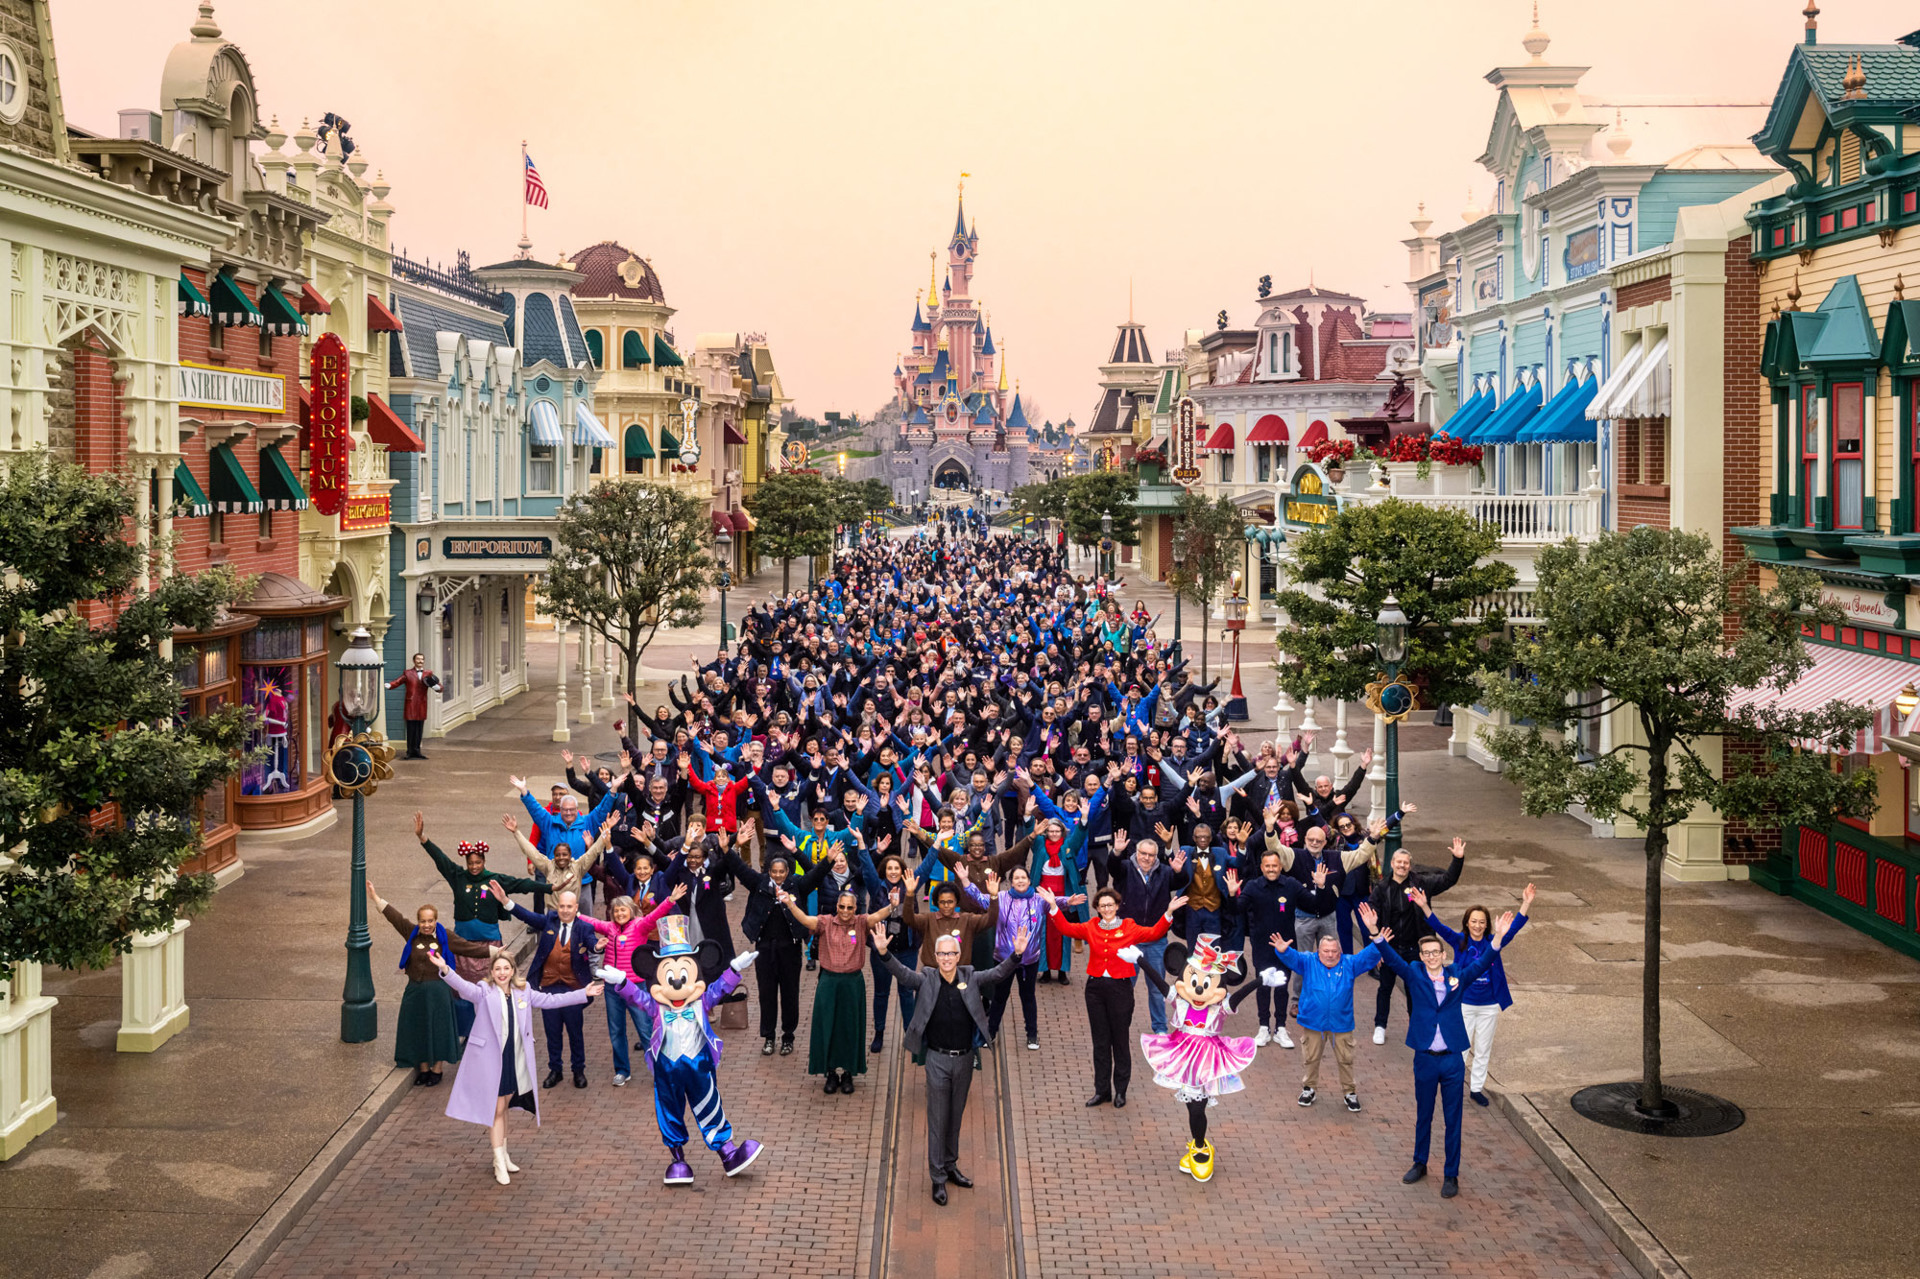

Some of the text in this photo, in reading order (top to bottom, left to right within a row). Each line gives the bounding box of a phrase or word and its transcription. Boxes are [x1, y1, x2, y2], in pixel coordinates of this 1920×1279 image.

[191, 371, 228, 401] STREET
[232, 376, 271, 405] GAZETTE
[319, 355, 338, 490] EMPORIUM
[450, 540, 543, 554] EMPORIUM
[1852, 594, 1882, 615] Sweets
